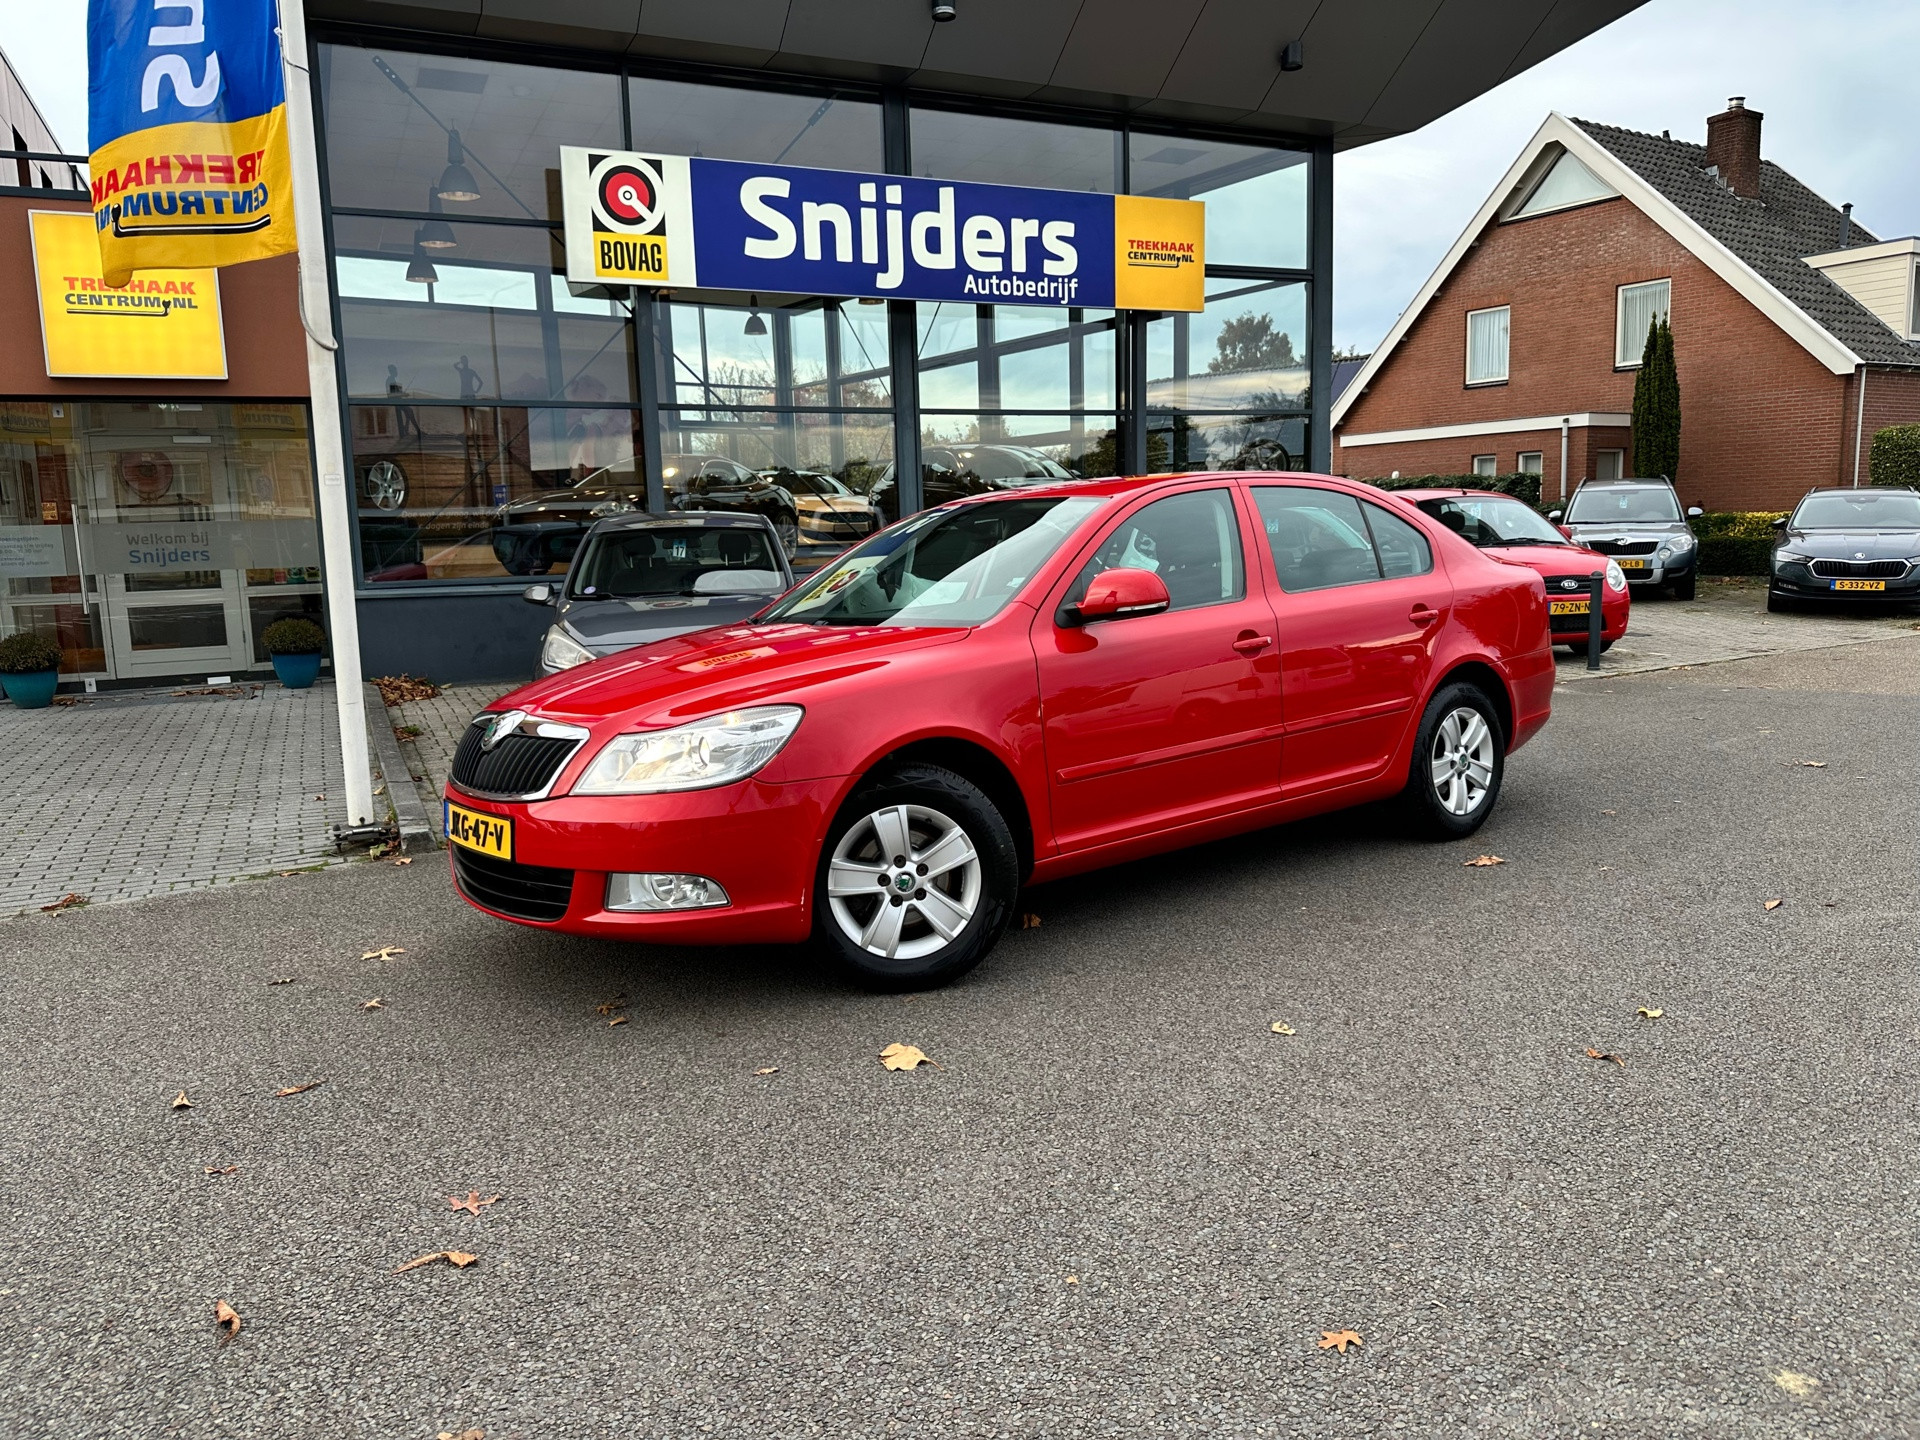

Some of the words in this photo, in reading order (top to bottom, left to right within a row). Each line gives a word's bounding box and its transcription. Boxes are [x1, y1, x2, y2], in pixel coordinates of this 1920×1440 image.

[740, 176, 1078, 290] Snijders
[1128, 239, 1195, 253] TREKHAAK
[600, 240, 662, 273] BOVAG
[63, 276, 196, 295] TREHAAK
[964, 274, 1079, 304] Autobedrijf
[126, 532, 188, 546] Welkom
[190, 531, 210, 547] bij
[129, 547, 210, 568] Snijders
[675, 546, 685, 556] 17
[1839, 581, 1881, 589] S-332-VZ
[451, 810, 504, 851] JKG-47-V
